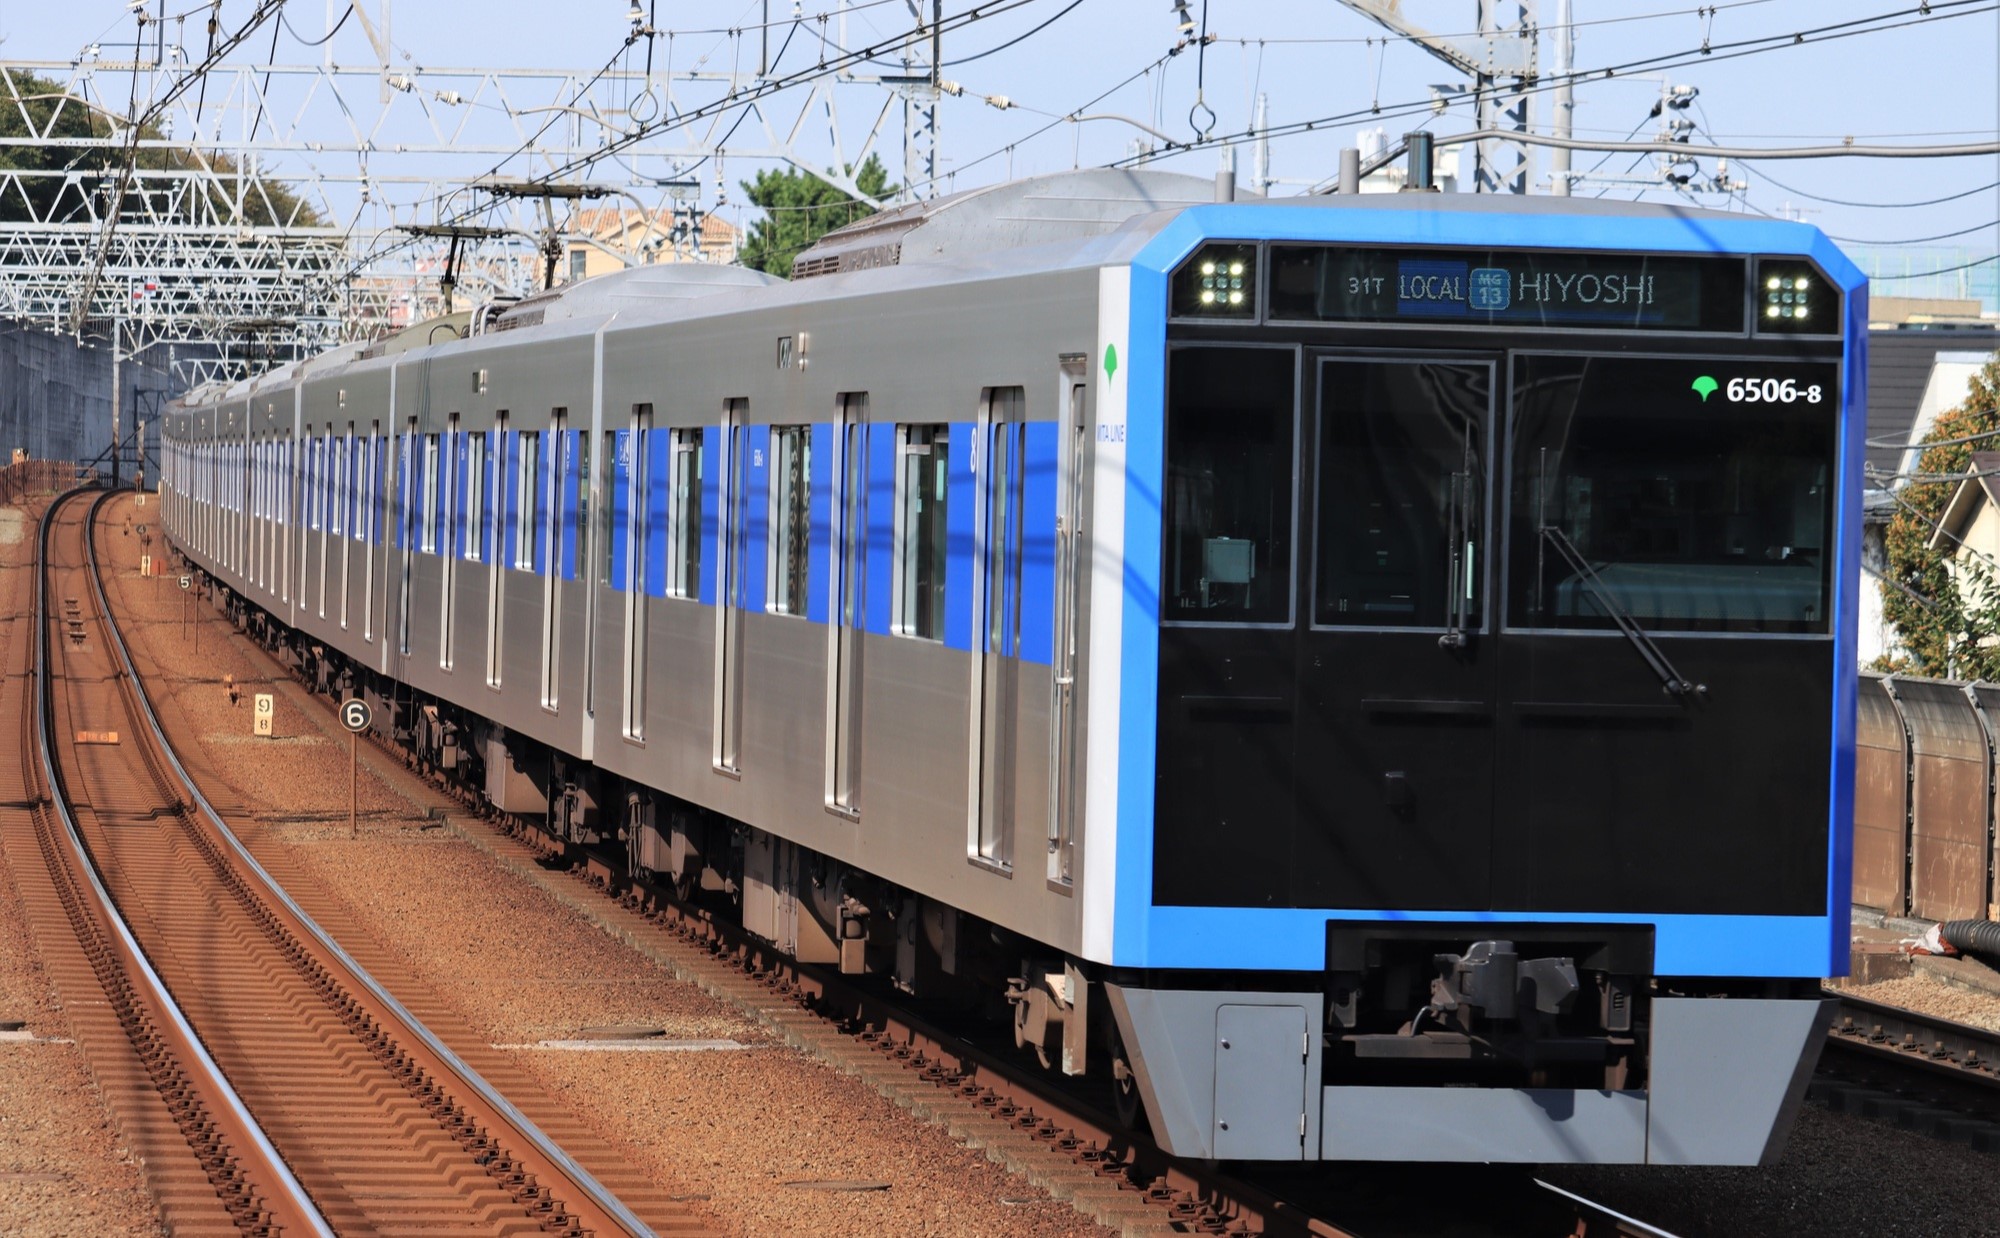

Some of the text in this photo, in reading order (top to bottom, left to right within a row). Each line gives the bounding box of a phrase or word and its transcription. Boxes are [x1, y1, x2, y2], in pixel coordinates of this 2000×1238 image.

[1349, 275, 1464, 300] 31T LOCAL
[1479, 287, 1502, 304] 13
[1518, 272, 1653, 305] HIYOSHI
[1726, 377, 1822, 403] 6506-8
[971, 427, 977, 473] 8
[180, 576, 189, 589] 5
[258, 698, 270, 713] 9
[346, 703, 364, 727] 6
[259, 719, 268, 730] 8
